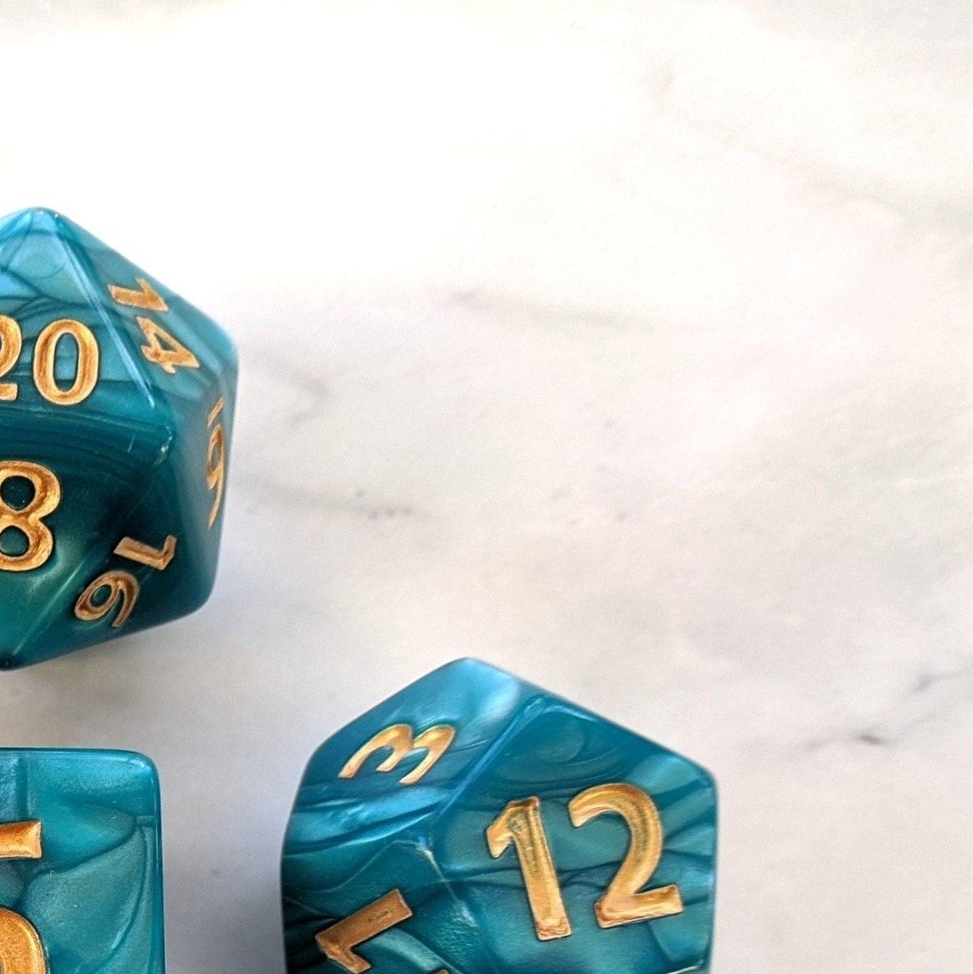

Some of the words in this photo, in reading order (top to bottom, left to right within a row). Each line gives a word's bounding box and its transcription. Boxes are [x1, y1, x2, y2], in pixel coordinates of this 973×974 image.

[109, 279, 198, 373] 14
[74, 536, 177, 627] 16
[337, 723, 456, 785] 3
[485, 782, 684, 941] 12
